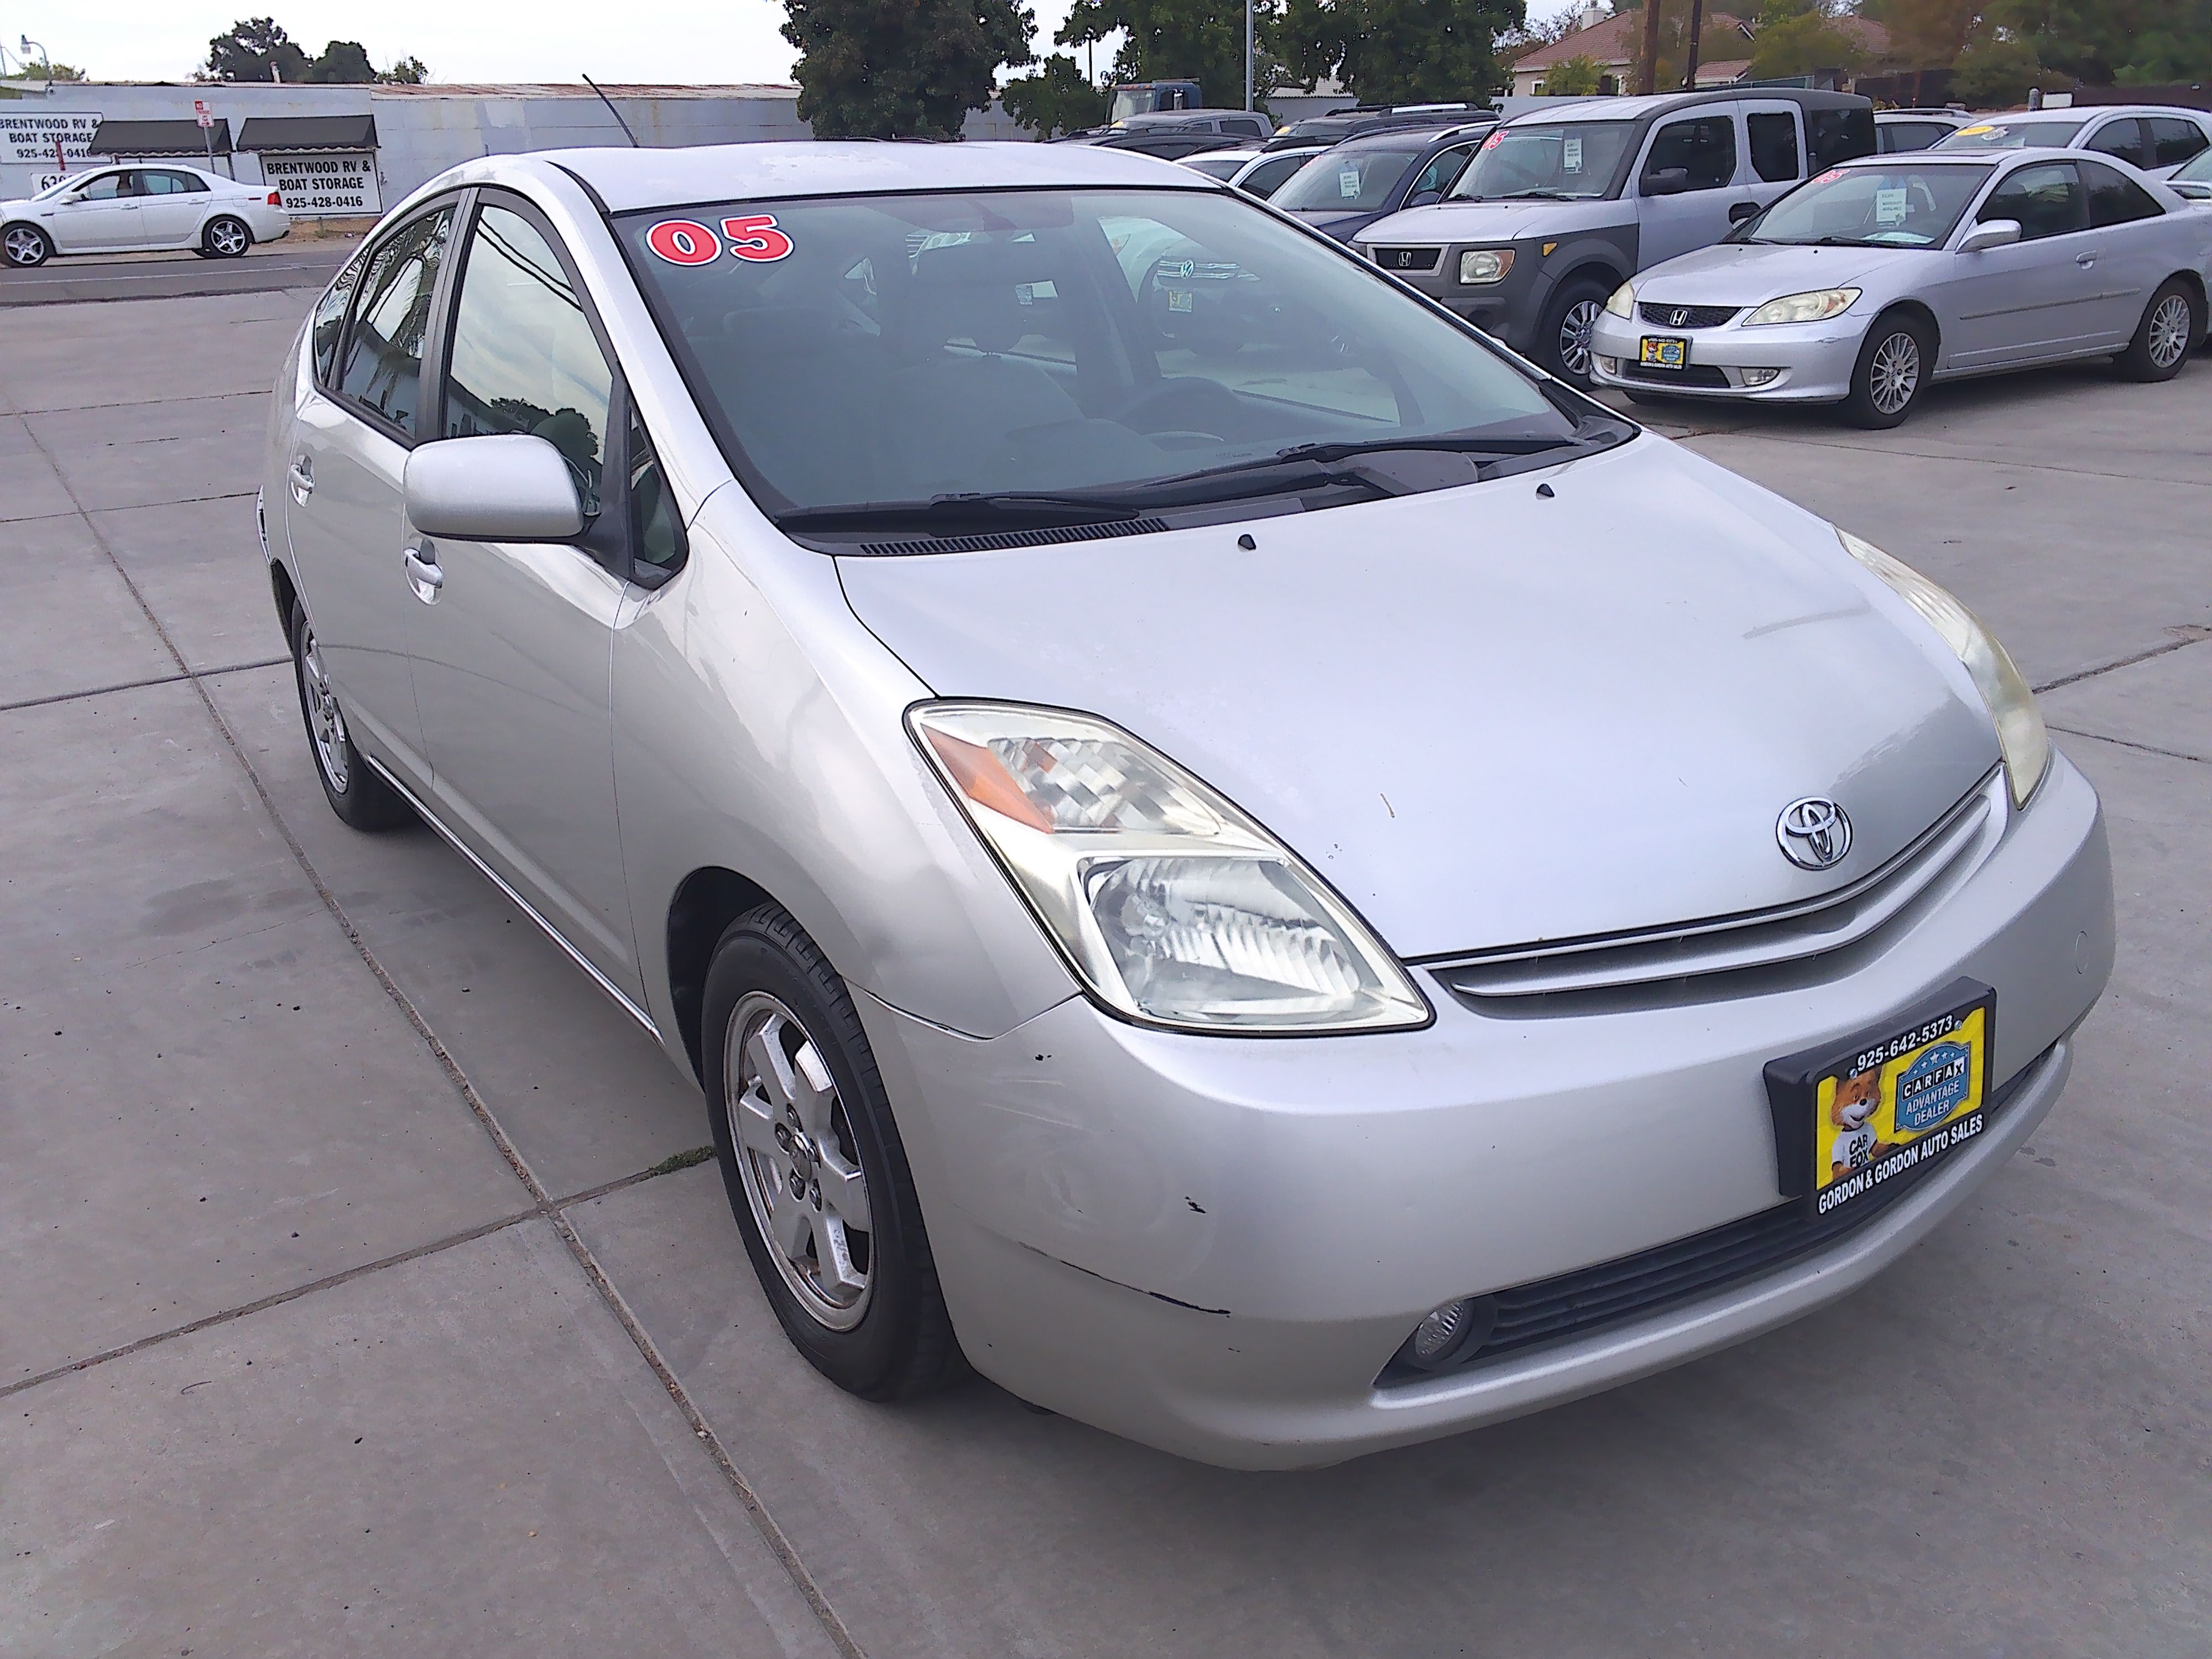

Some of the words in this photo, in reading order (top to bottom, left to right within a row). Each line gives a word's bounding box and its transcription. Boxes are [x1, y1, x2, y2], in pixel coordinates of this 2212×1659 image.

[72, 119, 86, 129] RV
[91, 119, 98, 128] &
[9, 133, 38, 143] BOAT
[42, 133, 93, 143] STORAGE
[17, 149, 91, 158] 925-42-0416
[267, 161, 338, 174] BRENTWOOD
[342, 161, 357, 173] RV
[362, 160, 371, 172] &
[279, 178, 307, 191] BOAT
[312, 177, 364, 190] STORAGE
[286, 196, 363, 208] 925-428-0416
[645, 213, 794, 267] 05
[1857, 1015, 1953, 1071] 925-642-5373
[1903, 1061, 1963, 1097] CARFAX
[1906, 1079, 1959, 1115] ADVANTAGE
[1914, 1099, 1949, 1126] DEALER
[1849, 1134, 1867, 1155] CAR
[1819, 1173, 1864, 1214] GORDON
[1865, 1169, 1873, 1189] &
[1875, 1145, 1918, 1183] GORDON
[1921, 1131, 1948, 1161] AUTO
[1951, 1114, 1983, 1145] SALES
[1850, 1148, 1869, 1168] FOX
